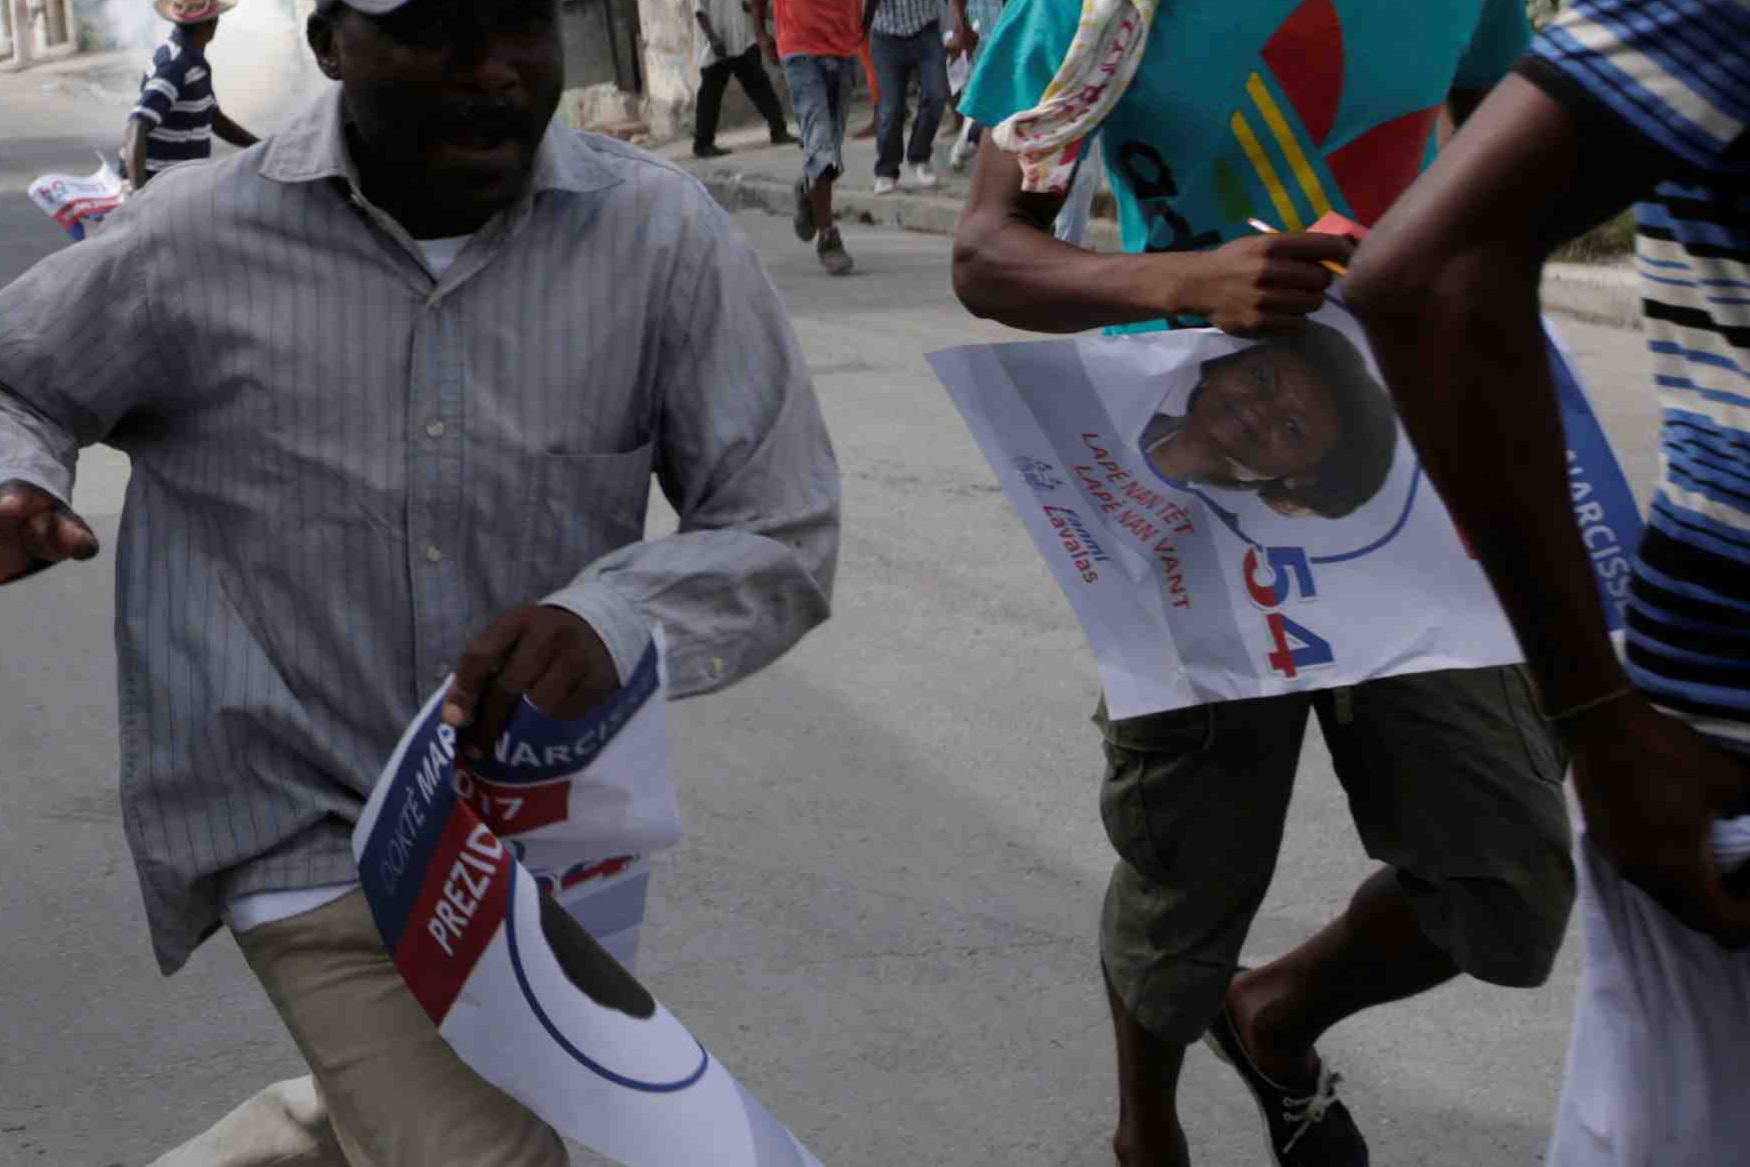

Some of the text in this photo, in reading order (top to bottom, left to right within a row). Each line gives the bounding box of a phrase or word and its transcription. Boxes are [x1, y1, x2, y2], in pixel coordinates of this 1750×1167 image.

[1042, 504, 1099, 585] Lavalas
[1154, 537, 1191, 610] VANT
[1242, 545, 1334, 678] 54
[416, 721, 457, 804] MAR
[427, 821, 505, 956] PREZID
